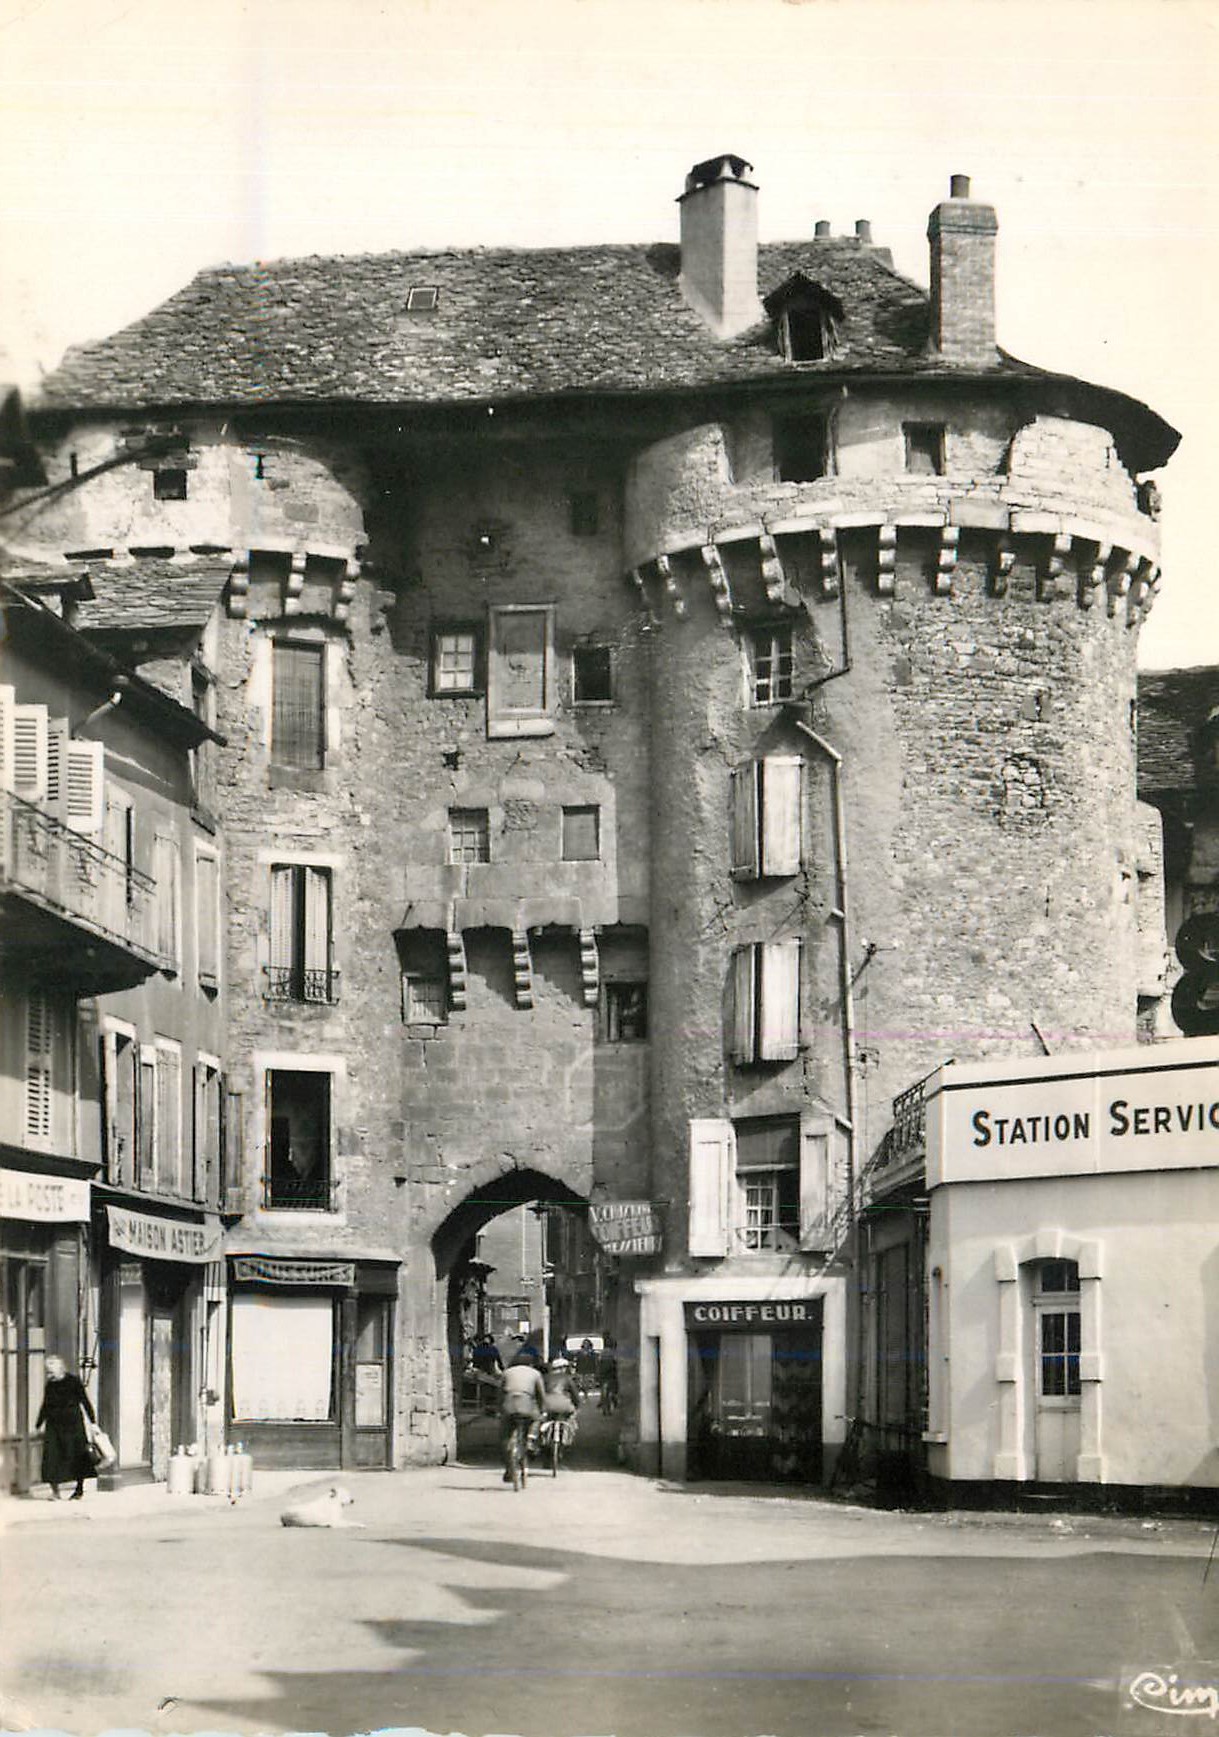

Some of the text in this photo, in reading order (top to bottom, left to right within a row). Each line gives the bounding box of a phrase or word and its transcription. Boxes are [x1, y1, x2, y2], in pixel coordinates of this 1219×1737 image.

[971, 1109, 1091, 1148] STATION
[128, 1217, 204, 1257] MAISON ASTIER
